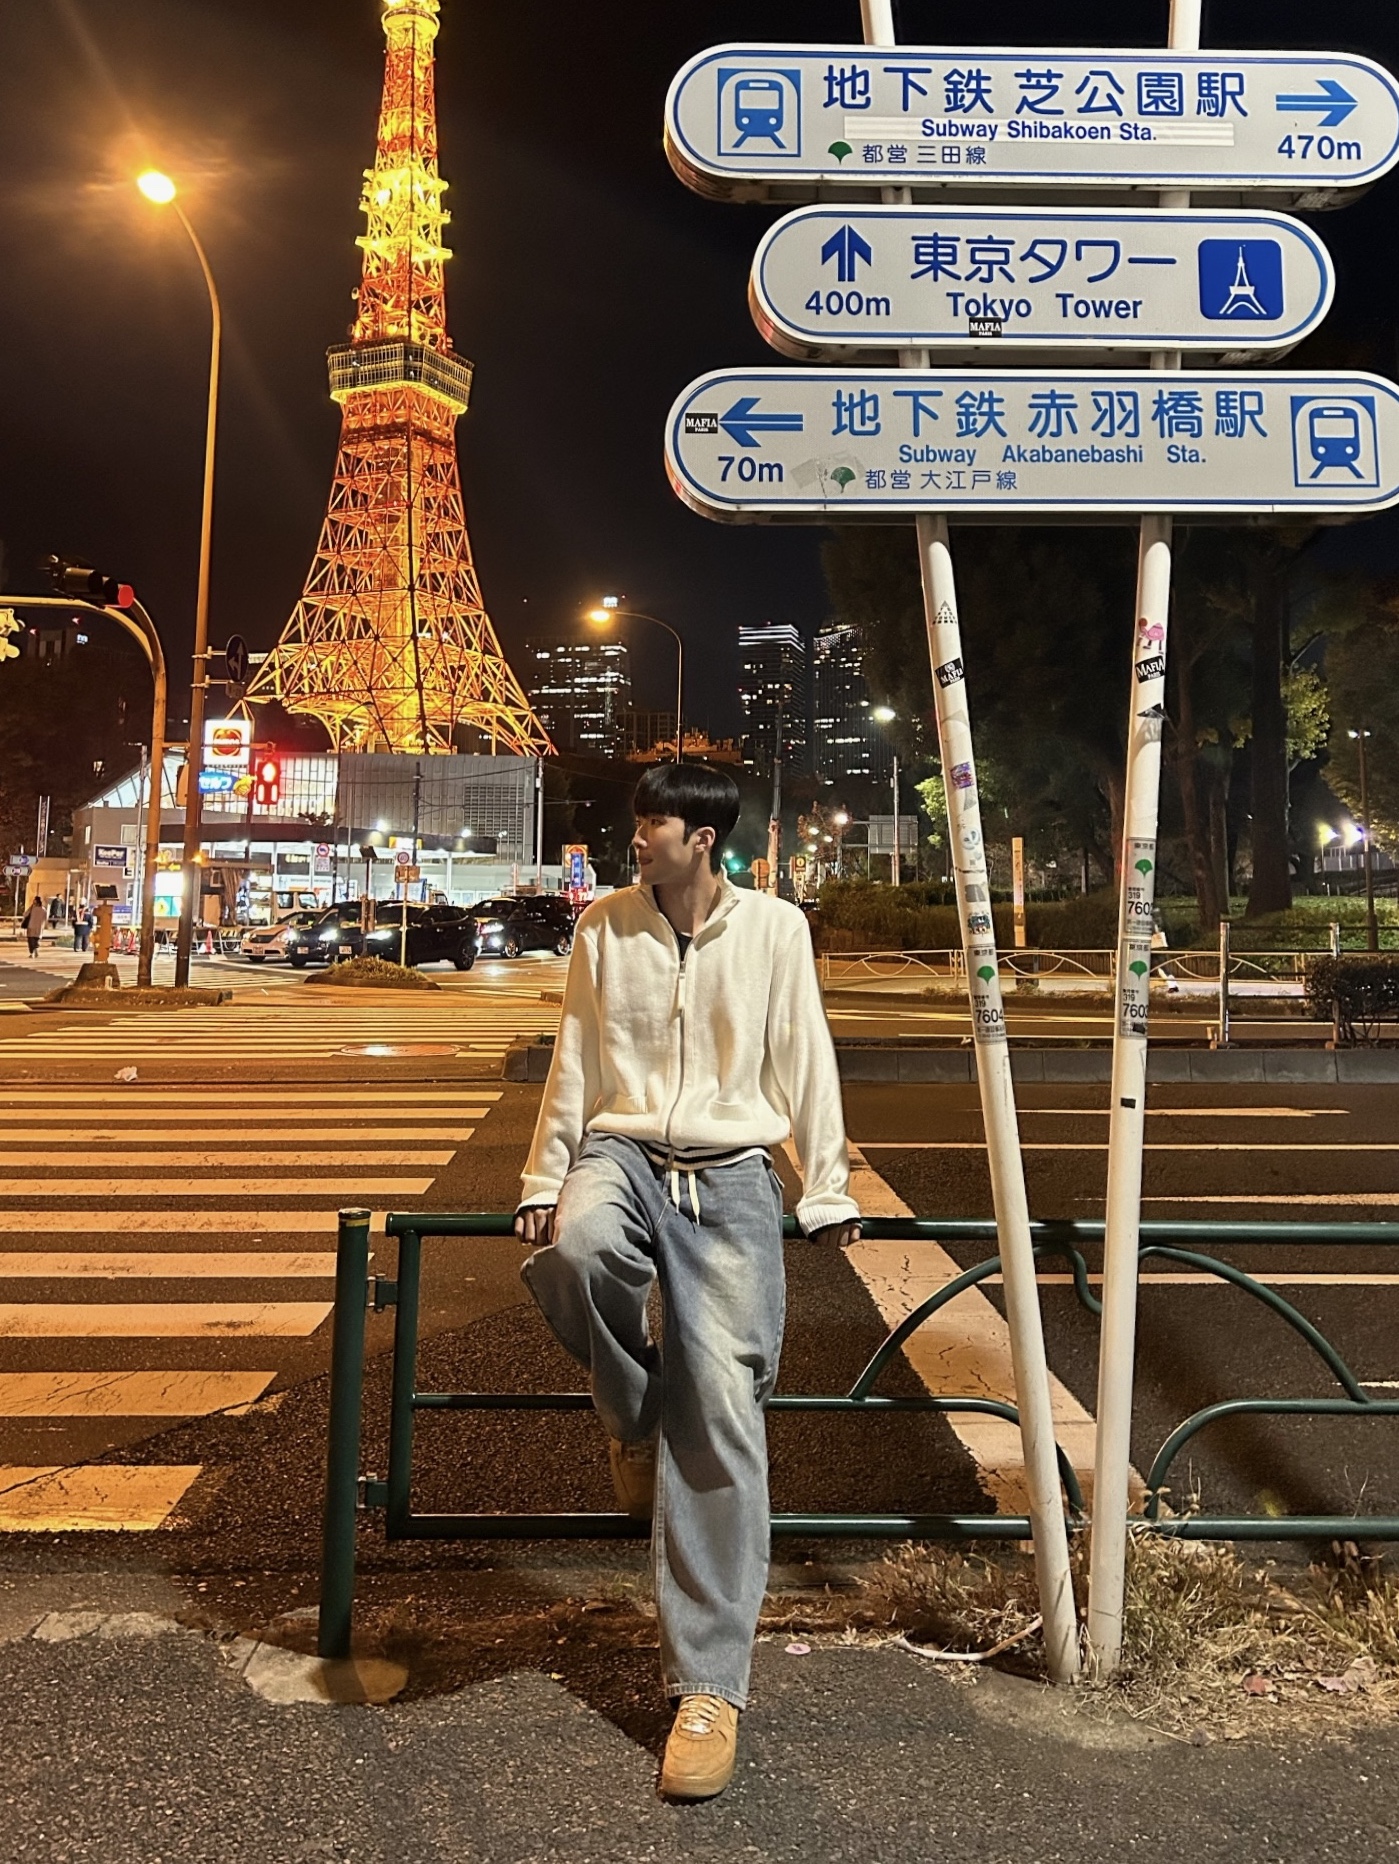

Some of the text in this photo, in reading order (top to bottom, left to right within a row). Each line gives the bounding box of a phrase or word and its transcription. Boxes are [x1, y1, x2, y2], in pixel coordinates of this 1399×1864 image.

[921, 119, 1157, 143] Subway Shibakoen Sta.
[1277, 135, 1363, 162] 470m
[910, 232, 1177, 284] 東京タワー
[804, 291, 892, 317] 400m
[946, 292, 1144, 323] Tokyo Tower
[969, 321, 1002, 332] MAFIA
[685, 417, 718, 428] MAFIA
[899, 444, 1208, 467] Subway Akabanebashi Sta.
[717, 456, 784, 483] 70m
[1136, 658, 1165, 678] MAFIA
